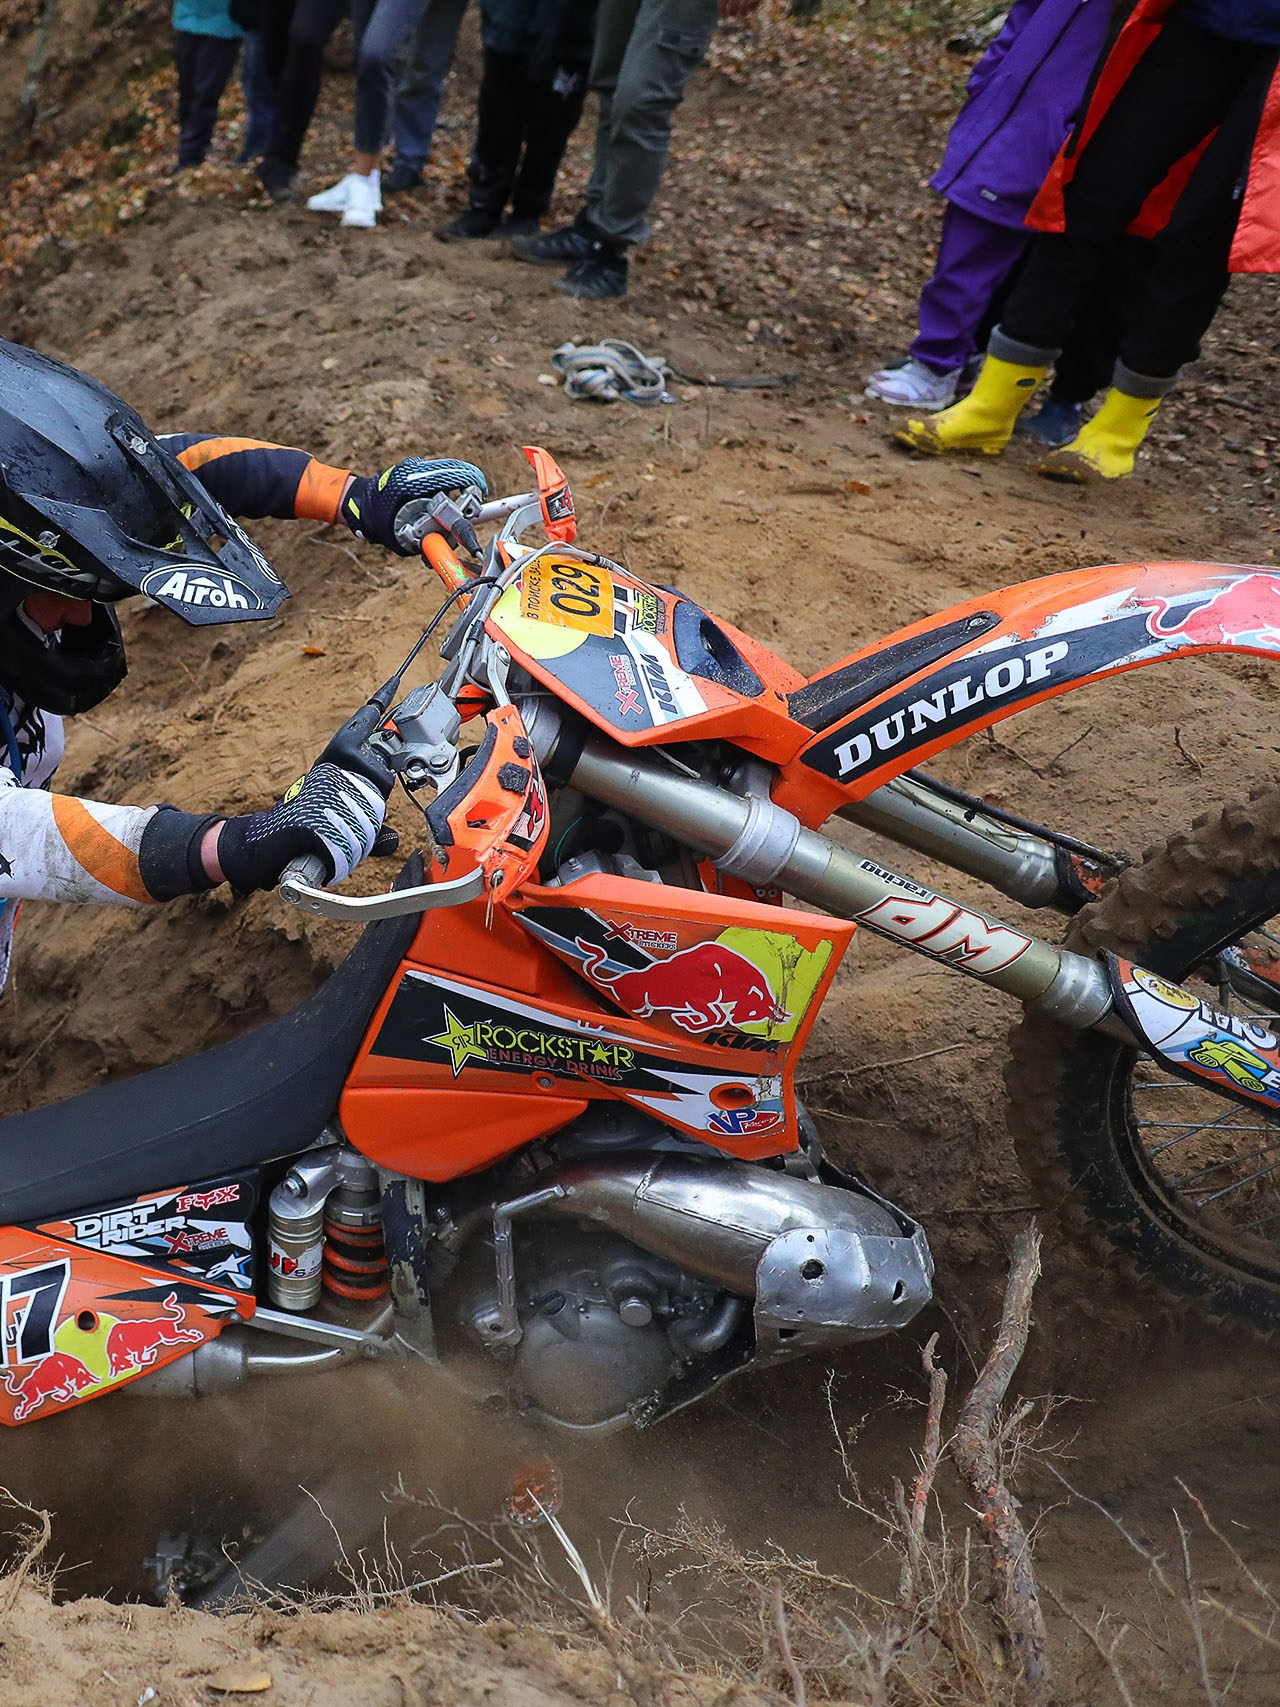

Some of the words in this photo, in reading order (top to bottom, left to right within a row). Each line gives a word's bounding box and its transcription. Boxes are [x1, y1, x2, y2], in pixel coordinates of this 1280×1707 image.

[155, 571, 249, 610] Airoh
[527, 576, 541, 611] ПОИСКЕ
[550, 564, 601, 617] 029
[640, 653, 679, 714] KTM
[833, 640, 1069, 778] DUNLOP
[860, 859, 928, 898] racing
[603, 920, 678, 943] XTREME
[476, 1022, 633, 1068] ROCKSTAR
[489, 1047, 558, 1068] ENERGY
[566, 1060, 621, 1079] DRINK
[707, 1108, 757, 1134] VP
[74, 1203, 157, 1238] DIRT
[101, 1215, 188, 1247] RIDER
[164, 1227, 229, 1254] XTREME
